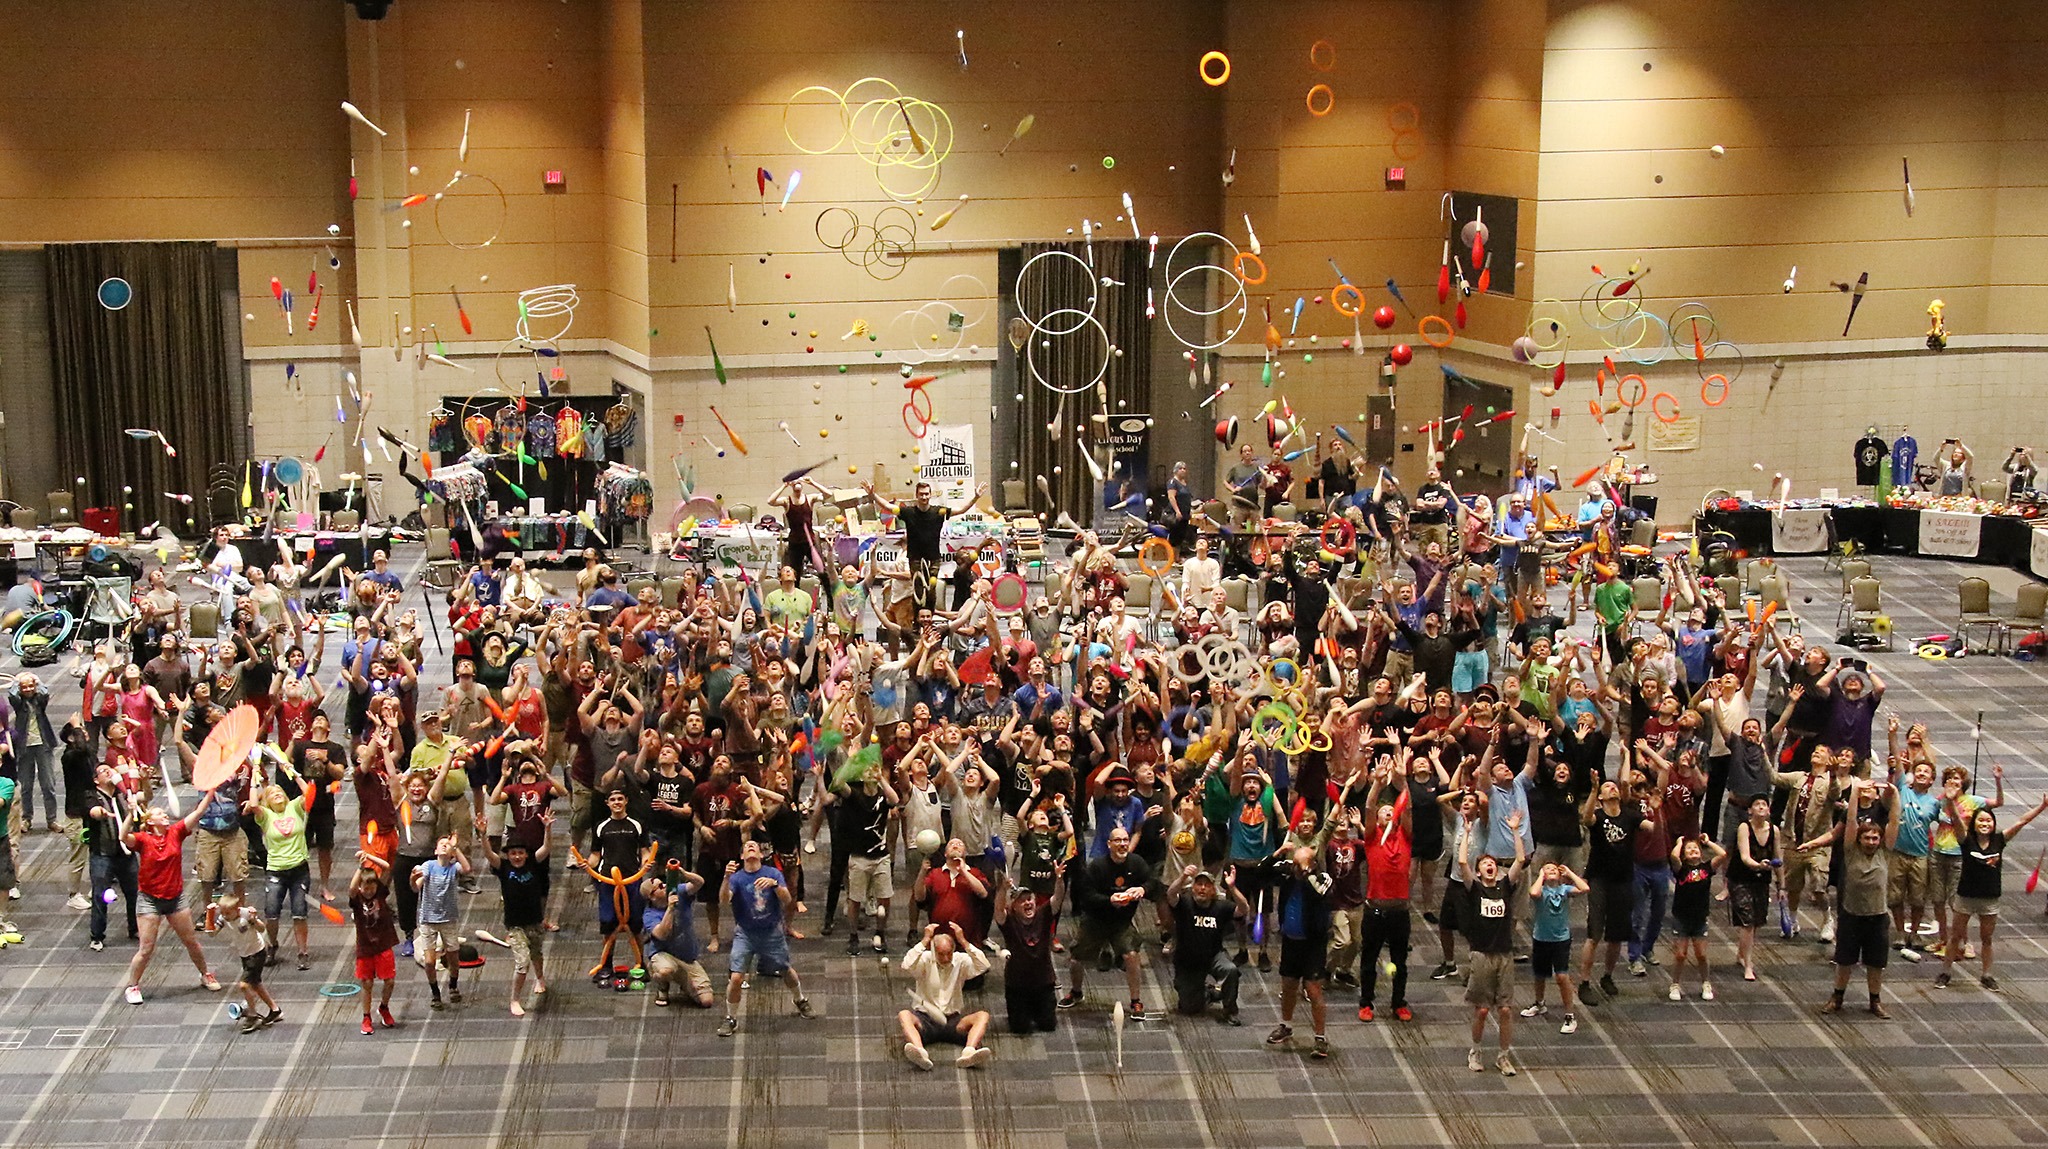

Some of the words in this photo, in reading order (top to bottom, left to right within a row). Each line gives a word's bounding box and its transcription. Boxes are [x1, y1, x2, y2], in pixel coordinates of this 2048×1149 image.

[546, 171, 561, 183] EXIT
[1126, 434, 1143, 445] Day
[923, 465, 970, 478] JUGGLING
[1484, 905, 1503, 916] 169
